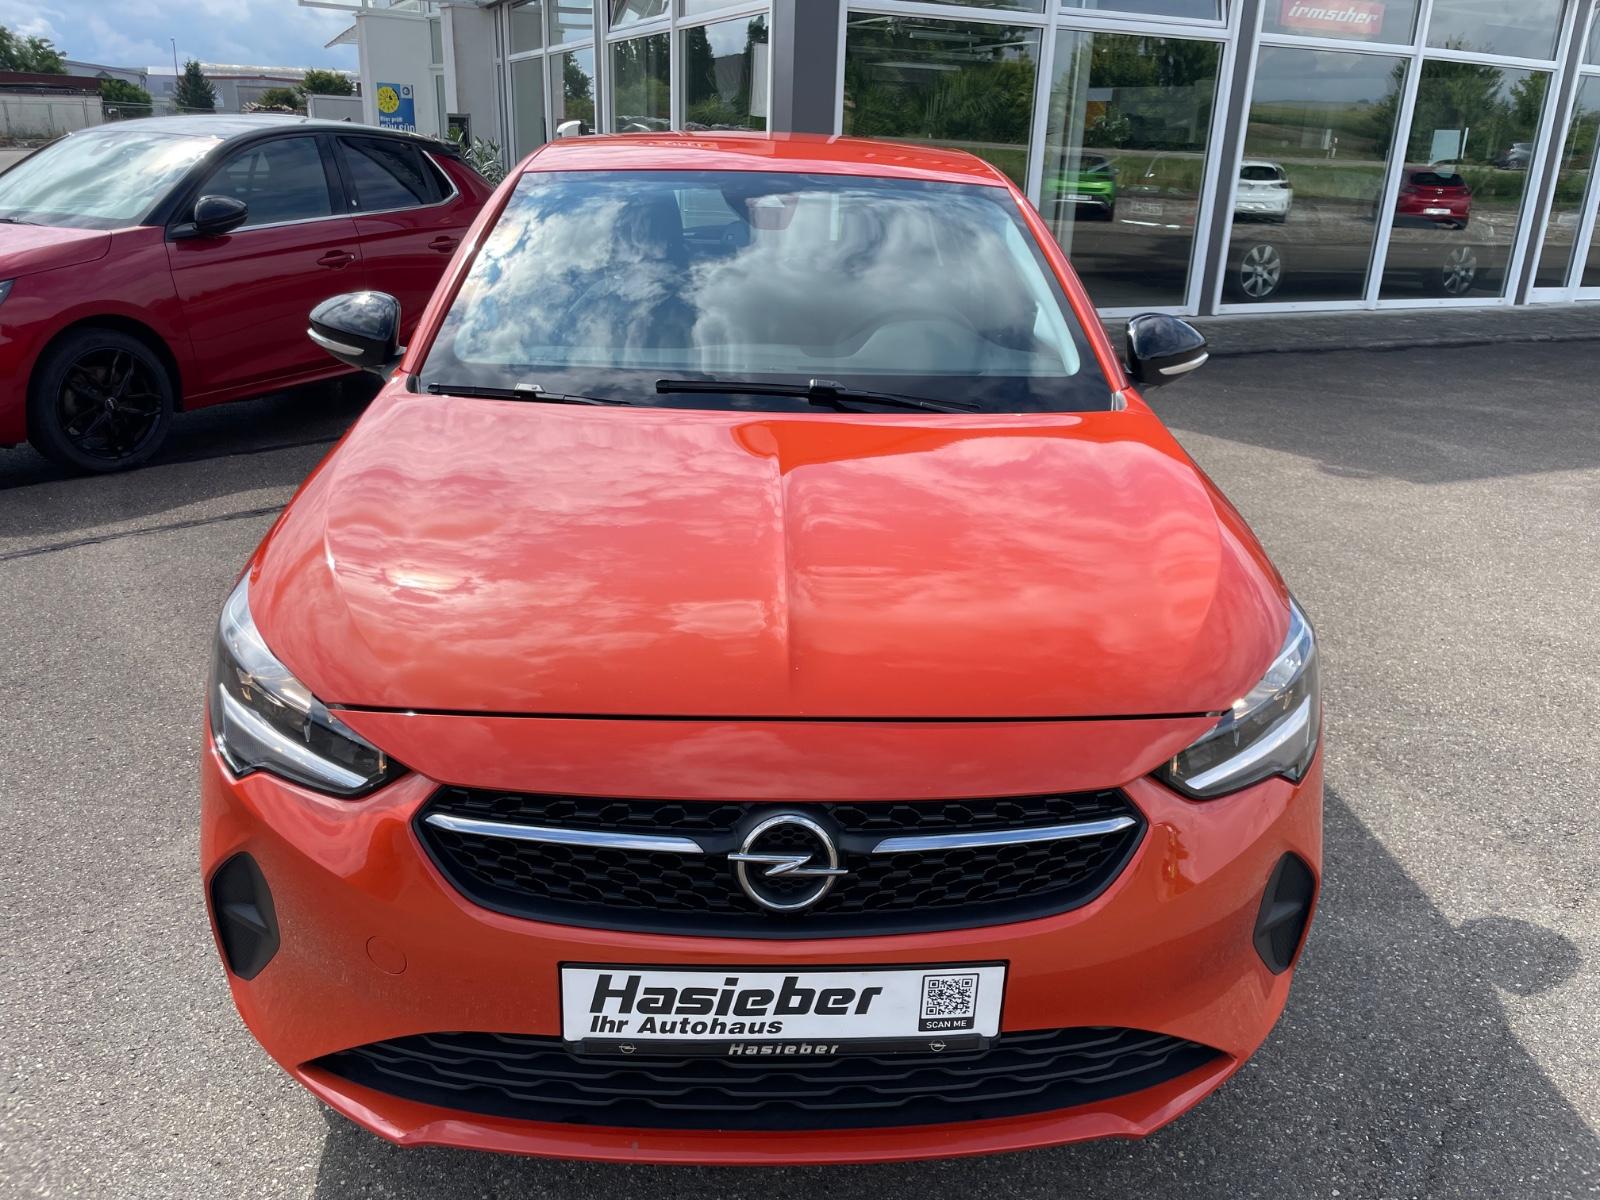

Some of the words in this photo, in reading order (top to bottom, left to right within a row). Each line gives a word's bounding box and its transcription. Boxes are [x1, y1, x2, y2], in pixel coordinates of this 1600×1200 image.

[1288, 1, 1378, 24] irmscher
[589, 974, 883, 1016] Hasieber
[590, 1015, 629, 1033] Ihr
[637, 1016, 783, 1034] Autohaus
[926, 1021, 951, 1029] SCAN
[728, 1042, 839, 1055] Hasieber
